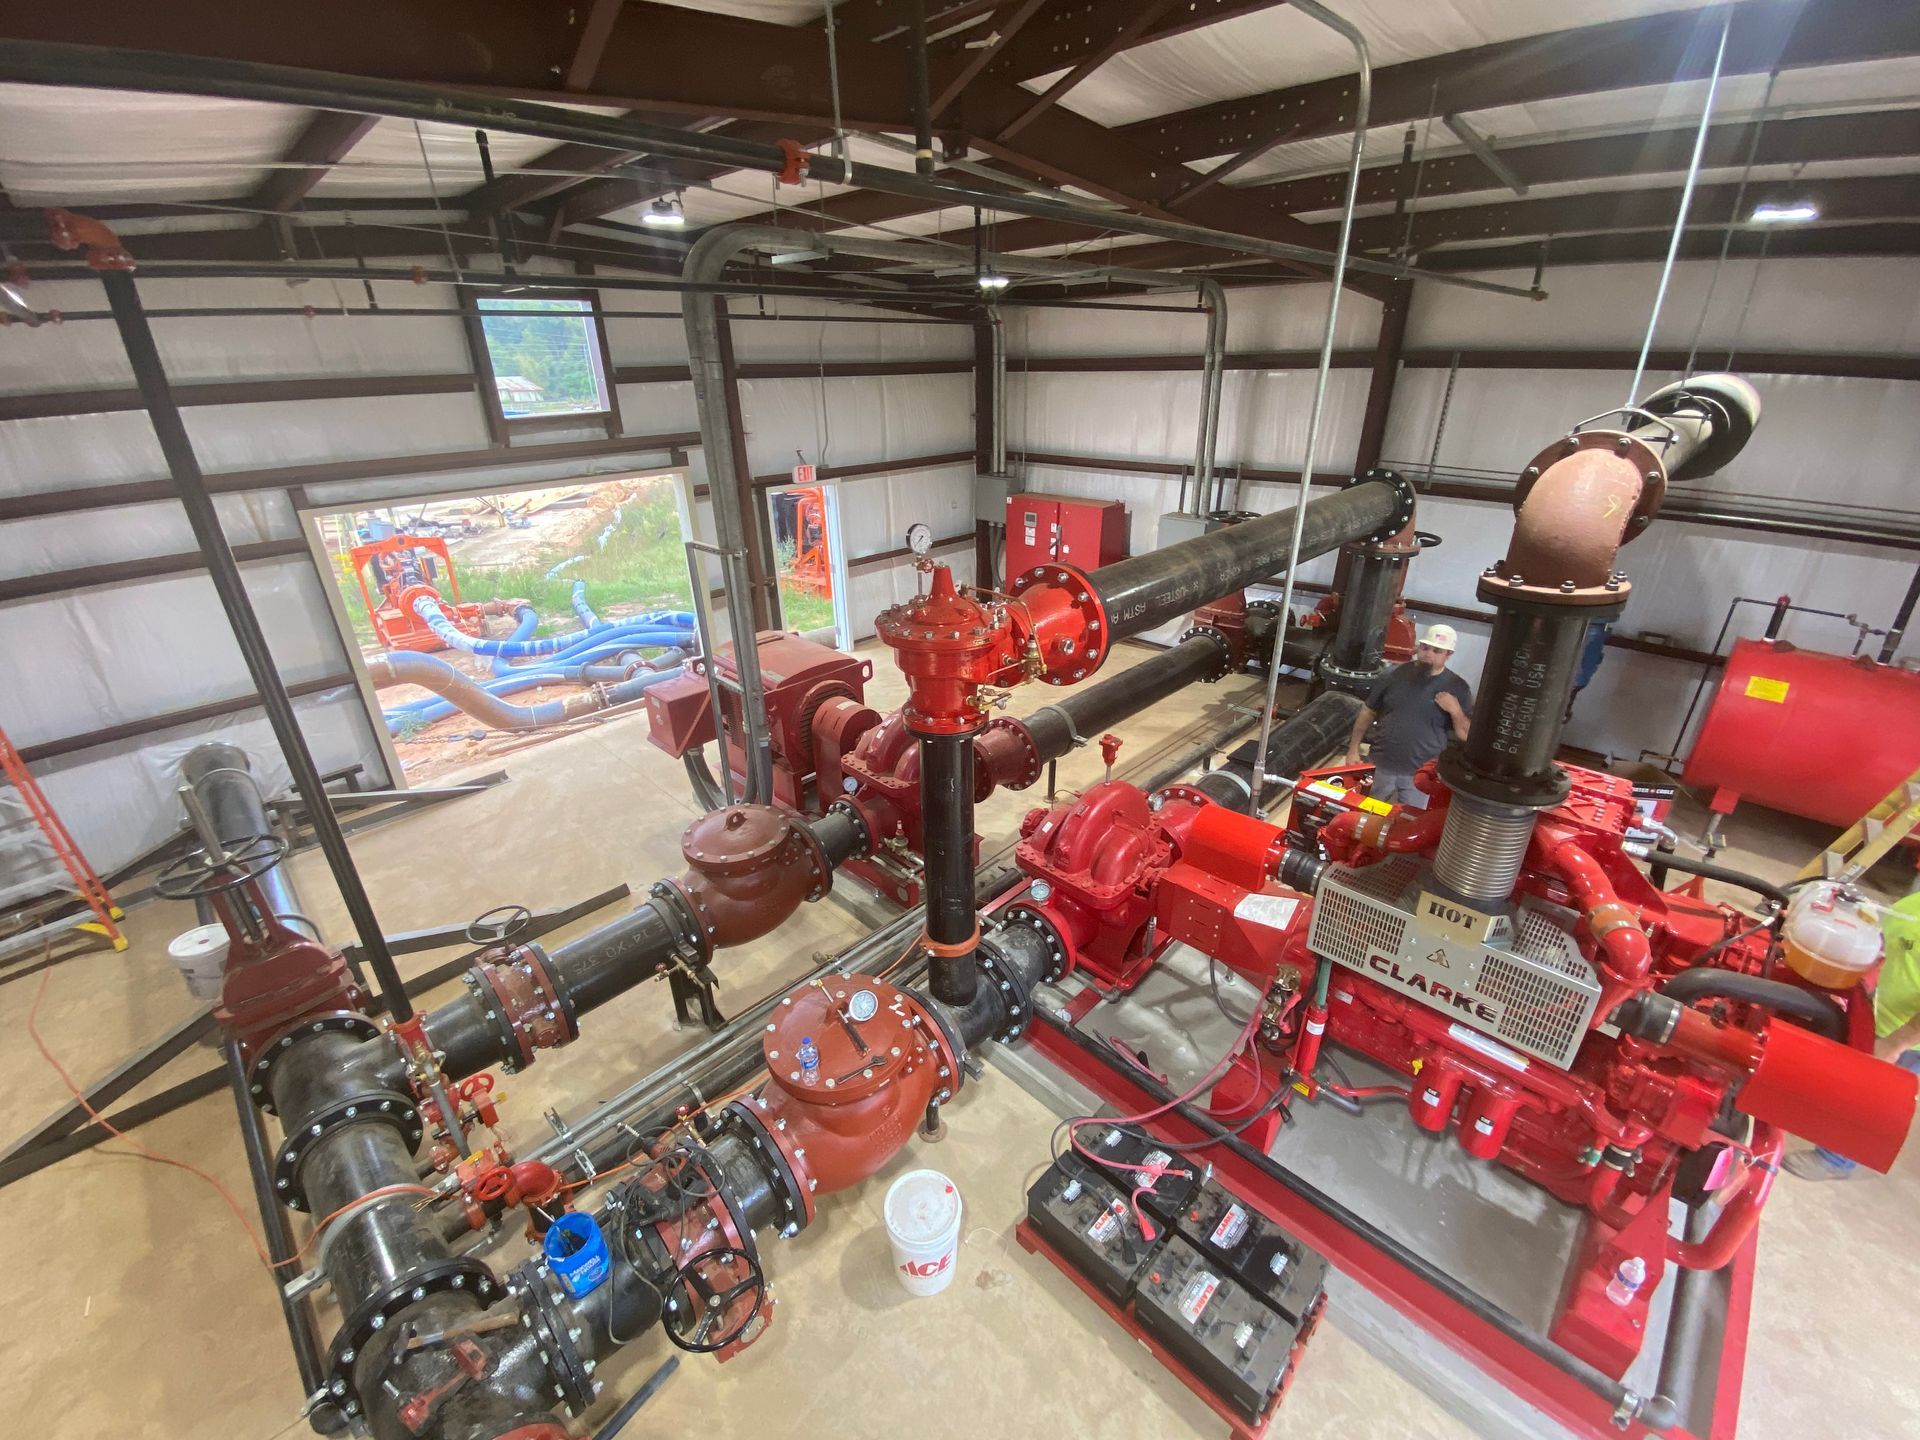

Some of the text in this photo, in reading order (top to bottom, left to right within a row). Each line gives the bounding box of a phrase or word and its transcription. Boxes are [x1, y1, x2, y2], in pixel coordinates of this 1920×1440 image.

[798, 466, 812, 481] EXIT
[1122, 602, 1146, 620] ASTM
[1428, 902, 1478, 930] HOT
[1369, 954, 1497, 1024] CLARKE
[1215, 1211, 1235, 1236] CLARKE
[899, 1248, 953, 1277] ACE
[1191, 1284, 1214, 1314] CLARKE
